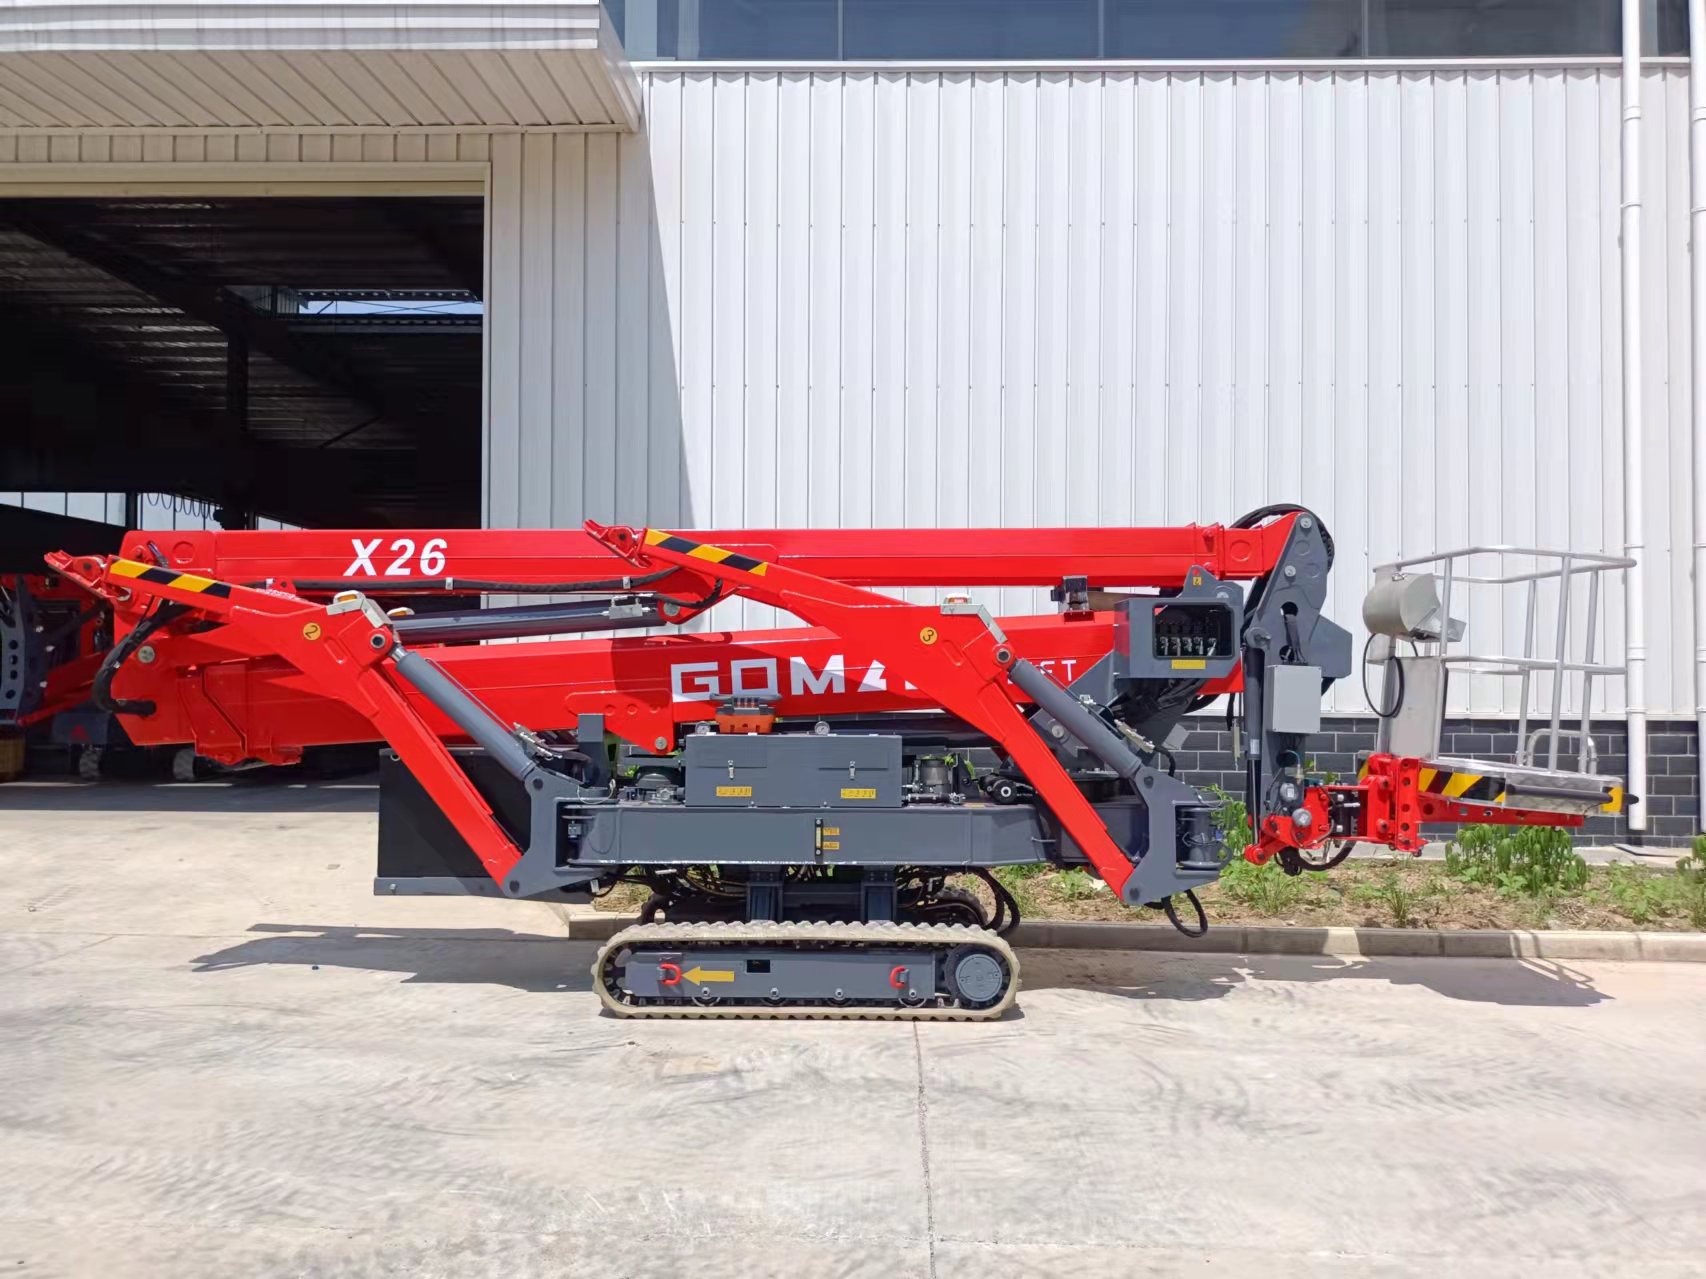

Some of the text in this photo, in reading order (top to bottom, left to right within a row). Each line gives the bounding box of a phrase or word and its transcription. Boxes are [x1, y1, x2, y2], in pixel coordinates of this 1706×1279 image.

[342, 537, 449, 577] X26
[304, 624, 319, 639] 2
[921, 628, 935, 643] 3
